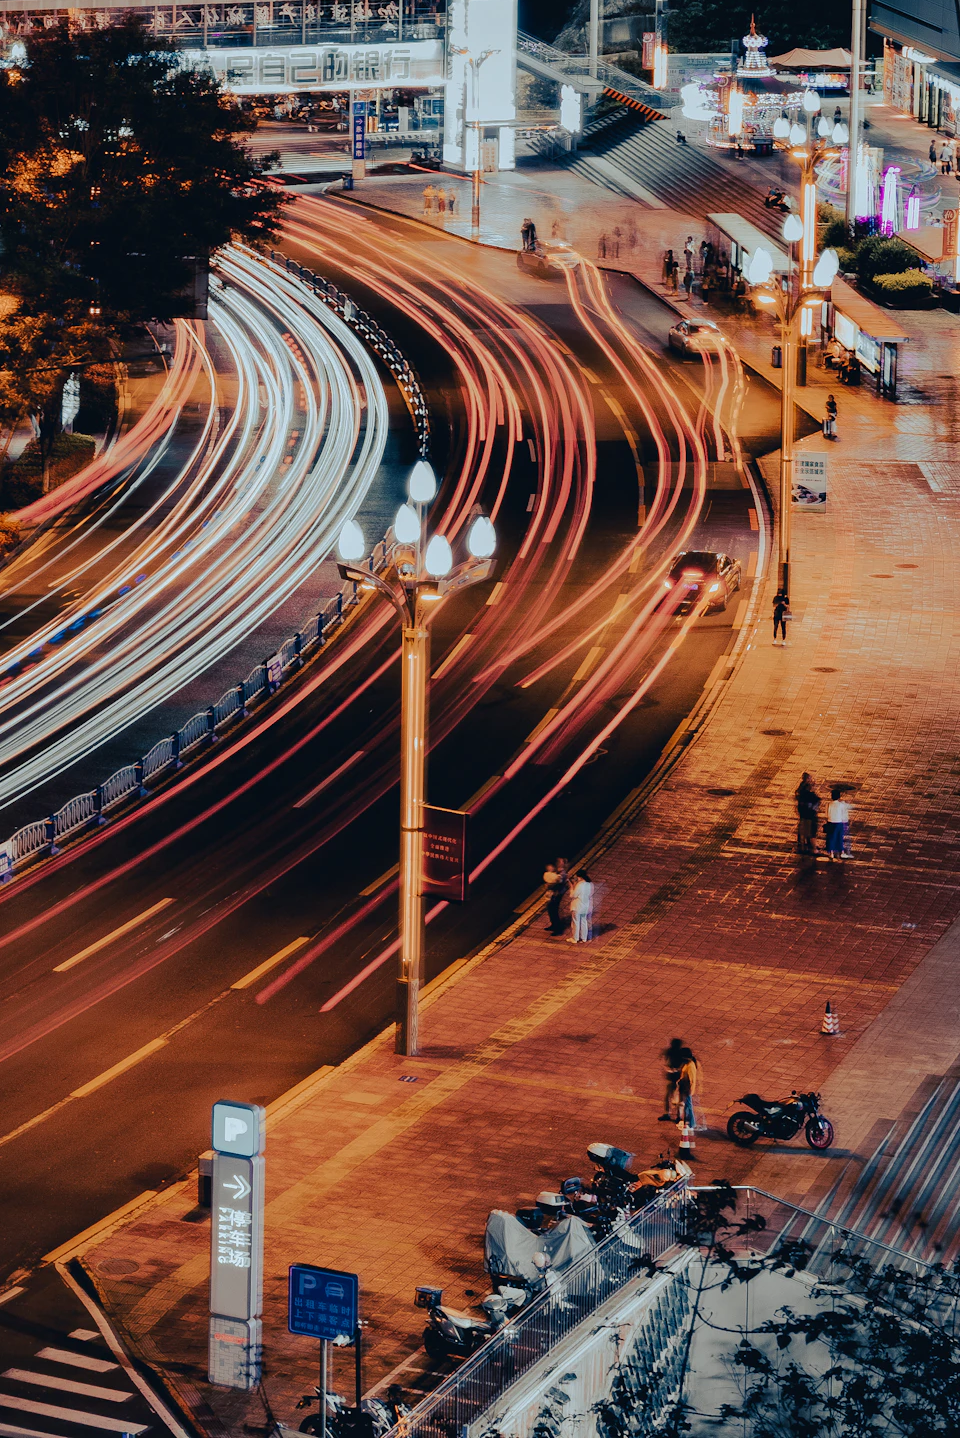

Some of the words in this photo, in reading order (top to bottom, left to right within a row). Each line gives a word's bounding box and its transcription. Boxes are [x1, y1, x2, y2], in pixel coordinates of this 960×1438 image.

[224, 1116, 248, 1142] P
[218, 1206, 231, 1264] PARKING
[229, 1209, 252, 1268] 停车场
[298, 1273, 317, 1295] P
[294, 1297, 351, 1316] 出租车临时
[294, 1308, 350, 1328] 上下乘客点
